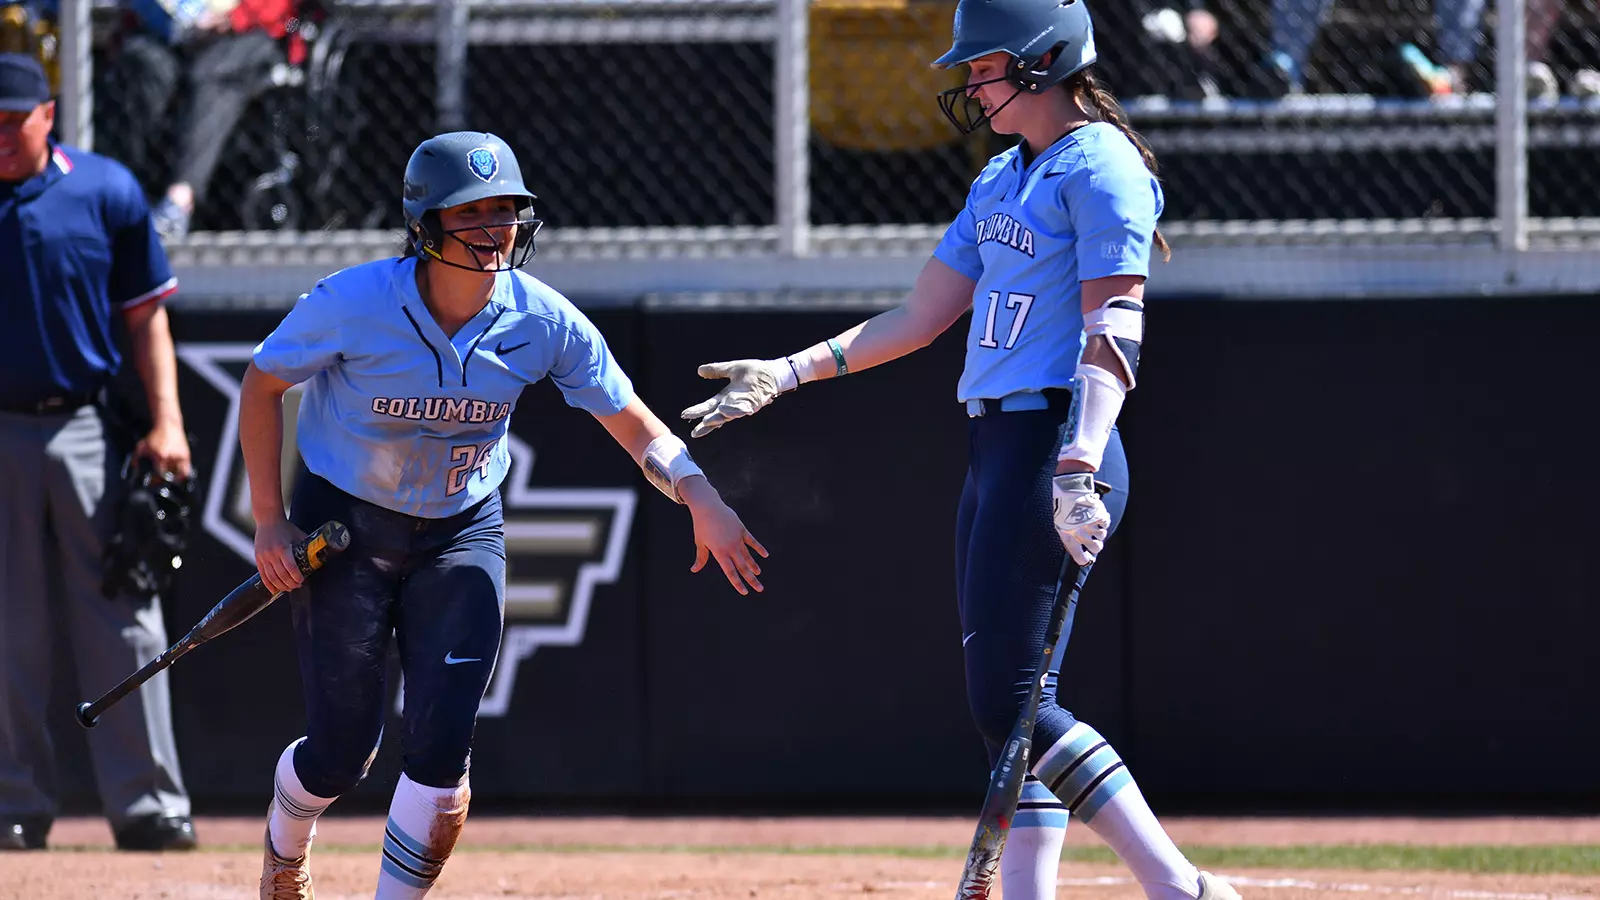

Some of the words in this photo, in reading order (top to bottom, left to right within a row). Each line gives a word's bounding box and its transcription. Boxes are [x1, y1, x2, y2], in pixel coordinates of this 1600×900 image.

[979, 290, 1036, 350] 17
[372, 397, 512, 424] COLUMBIA
[445, 440, 499, 498] 24
